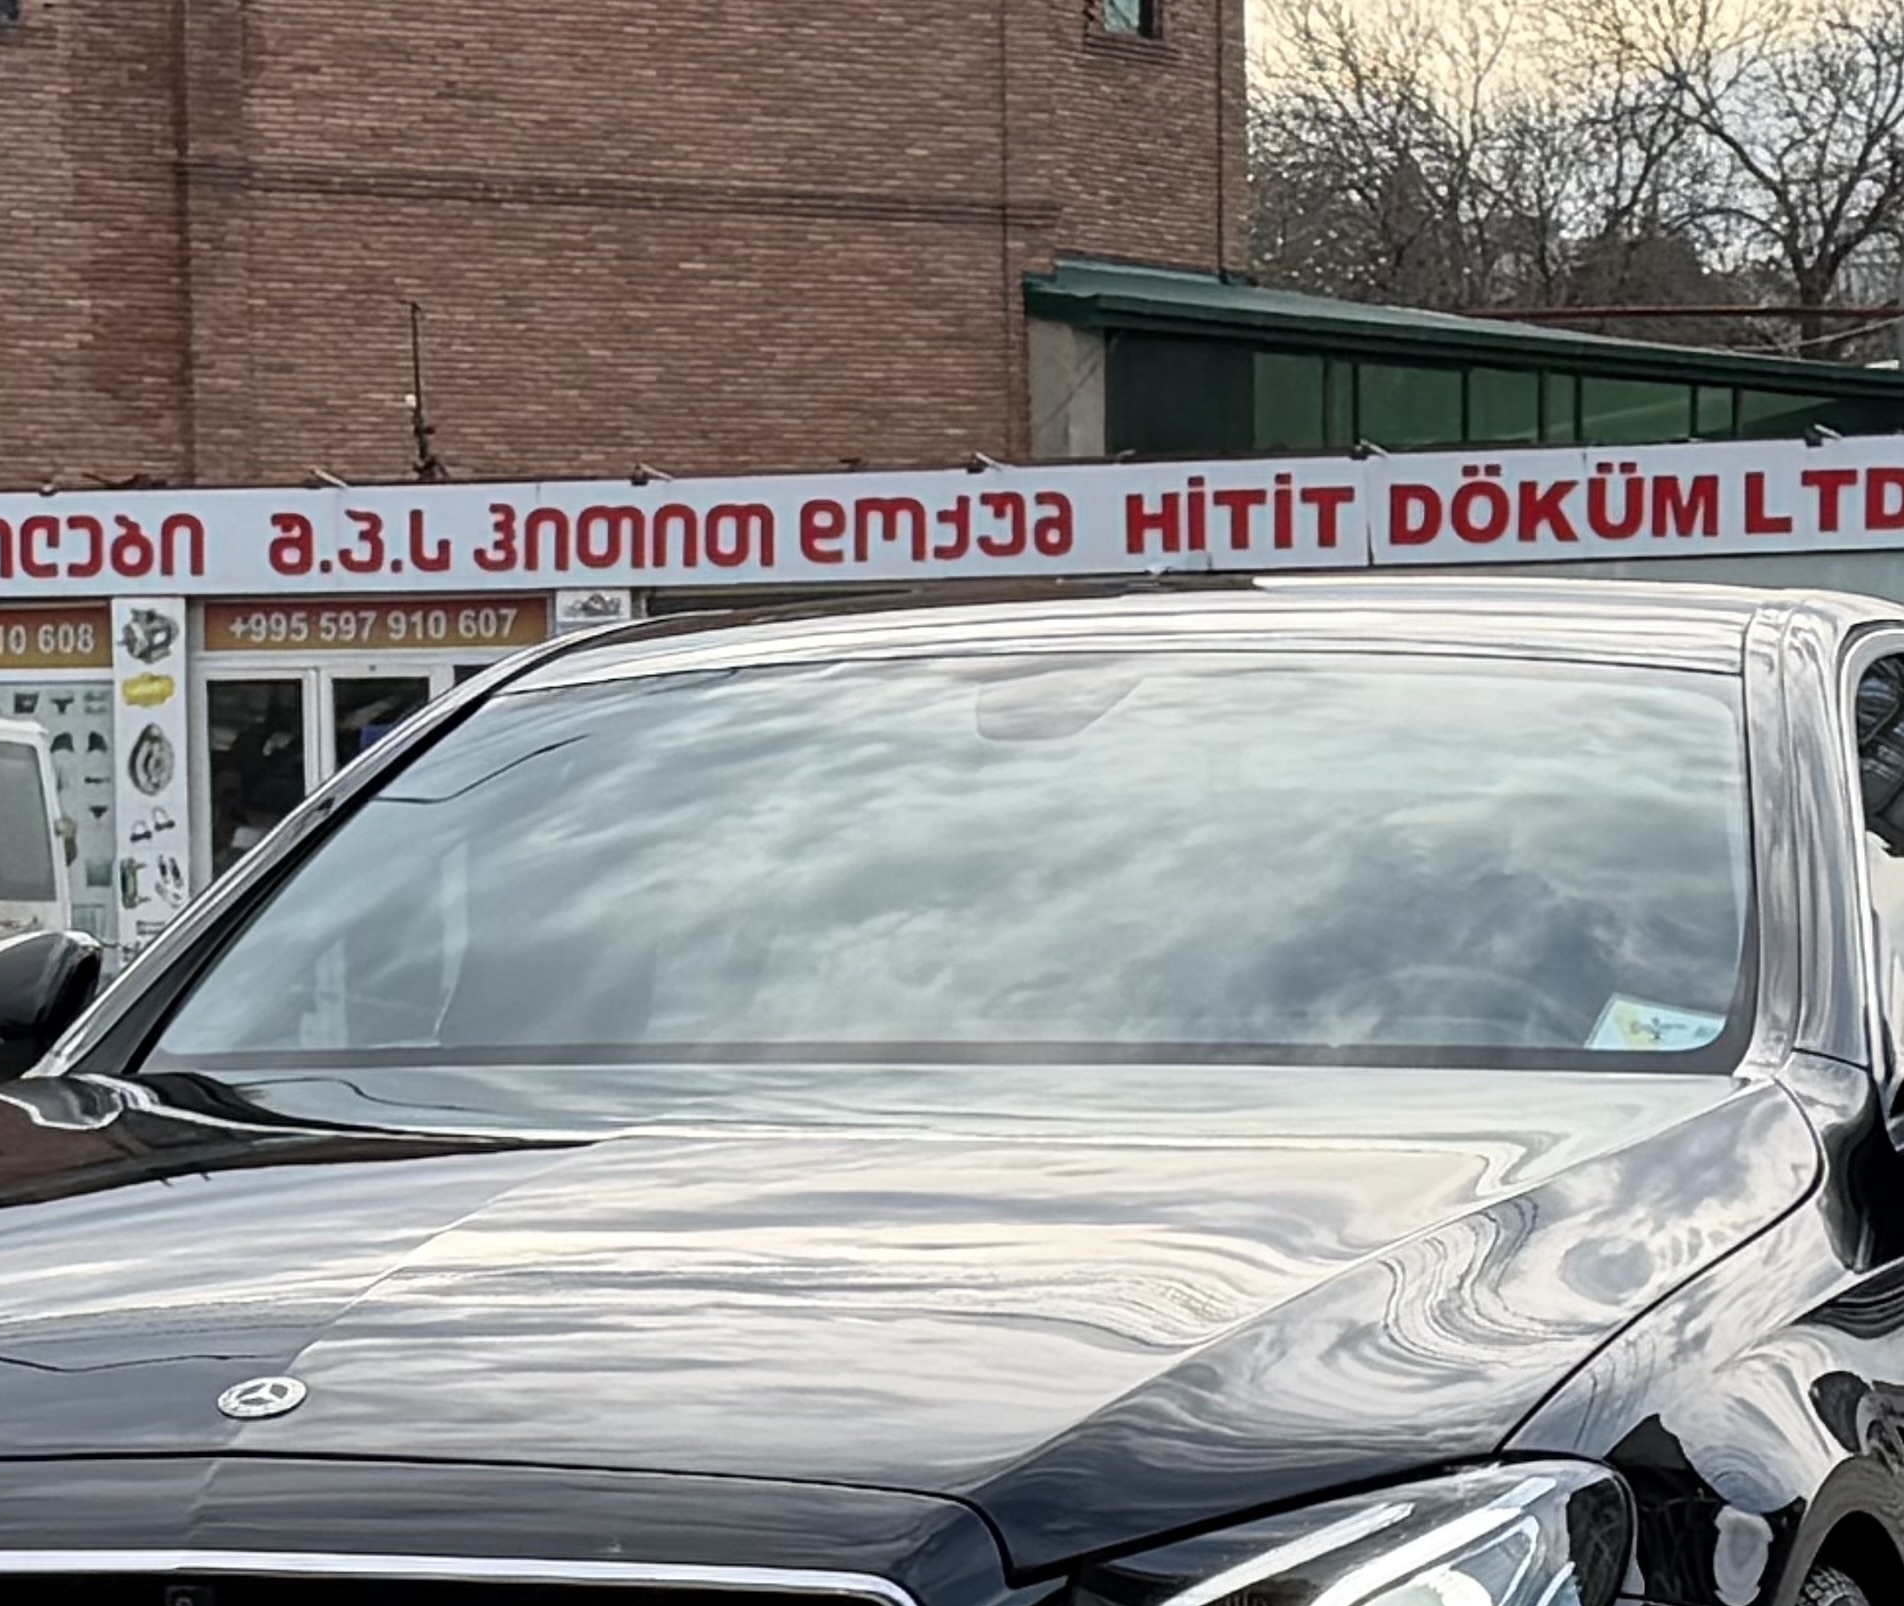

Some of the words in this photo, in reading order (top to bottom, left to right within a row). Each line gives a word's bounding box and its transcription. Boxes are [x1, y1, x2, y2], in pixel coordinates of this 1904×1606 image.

[1389, 463, 1719, 546] DÖKÜM
[37, 623, 96, 654] 608
[229, 611, 309, 642] +995
[319, 610, 377, 642] 597
[387, 609, 447, 641] 910
[457, 607, 517, 639] 607
